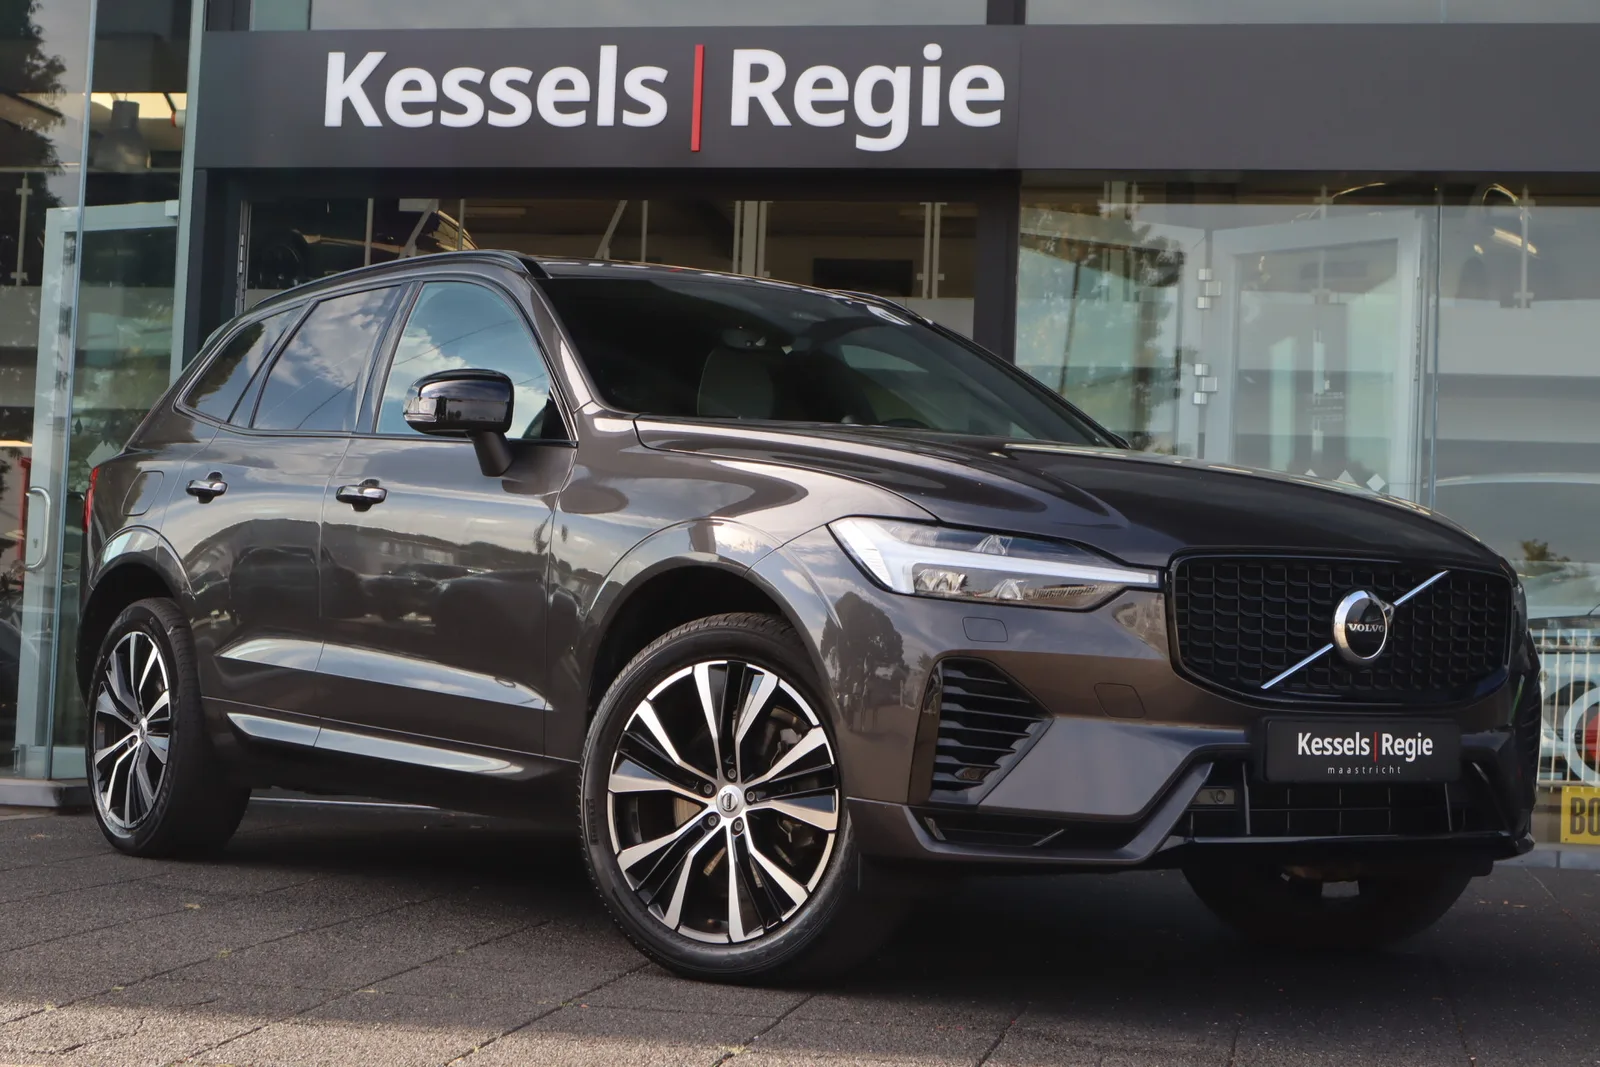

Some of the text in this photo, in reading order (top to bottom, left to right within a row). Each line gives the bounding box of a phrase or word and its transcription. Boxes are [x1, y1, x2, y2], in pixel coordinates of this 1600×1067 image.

[324, 43, 1006, 152] Kessels Regie
[1347, 623, 1385, 633] VOLVO
[1297, 731, 1434, 763] Kessels Regie
[1327, 765, 1401, 775] maastricht
